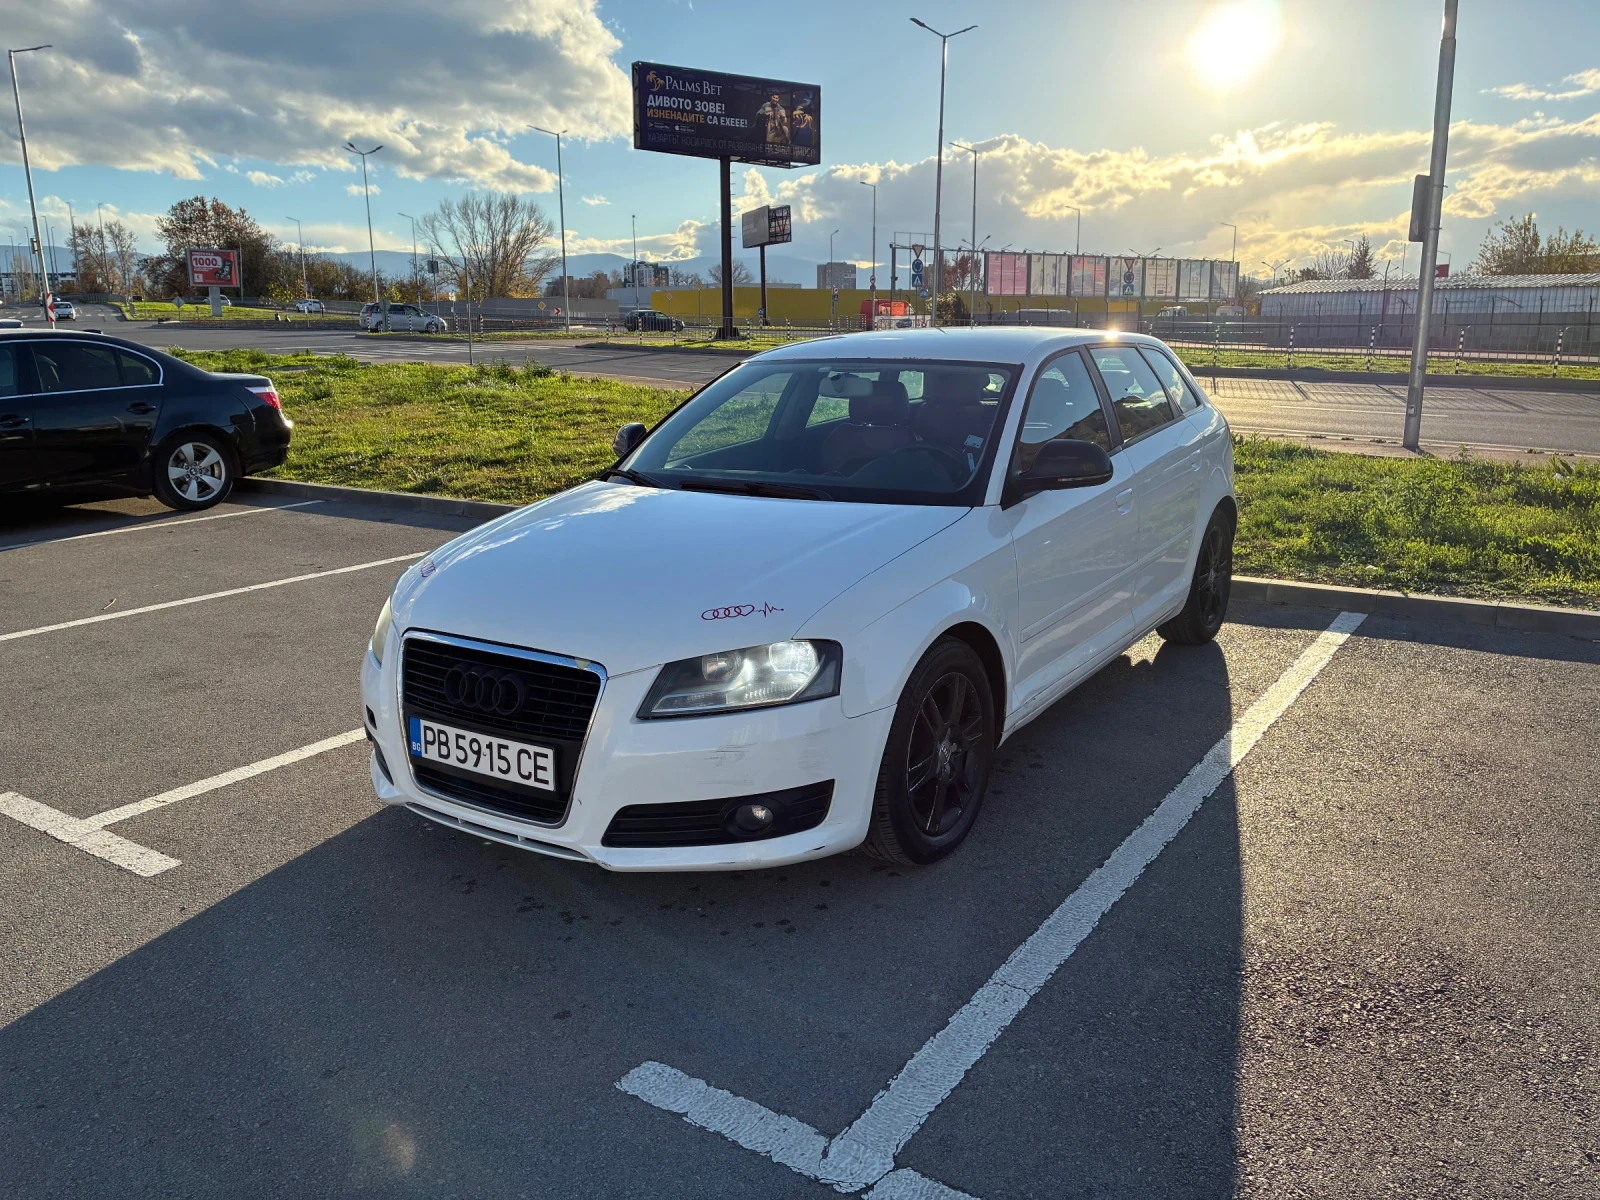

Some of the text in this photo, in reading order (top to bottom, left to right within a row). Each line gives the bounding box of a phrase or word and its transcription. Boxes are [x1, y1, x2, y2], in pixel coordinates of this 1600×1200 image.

[646, 94, 725, 115] ДИВОТО ЗОВЕ!
[646, 108, 705, 124] ИЗНЕНАДИТЕ
[647, 132, 680, 145] ХАЗАРТЪТ
[681, 135, 700, 147] НОСИ
[700, 137, 718, 149] РИСК
[718, 139, 727, 150] ОТ
[193, 257, 218, 267] 1000
[412, 741, 421, 751] BG
[455, 733, 511, 775] 5915
